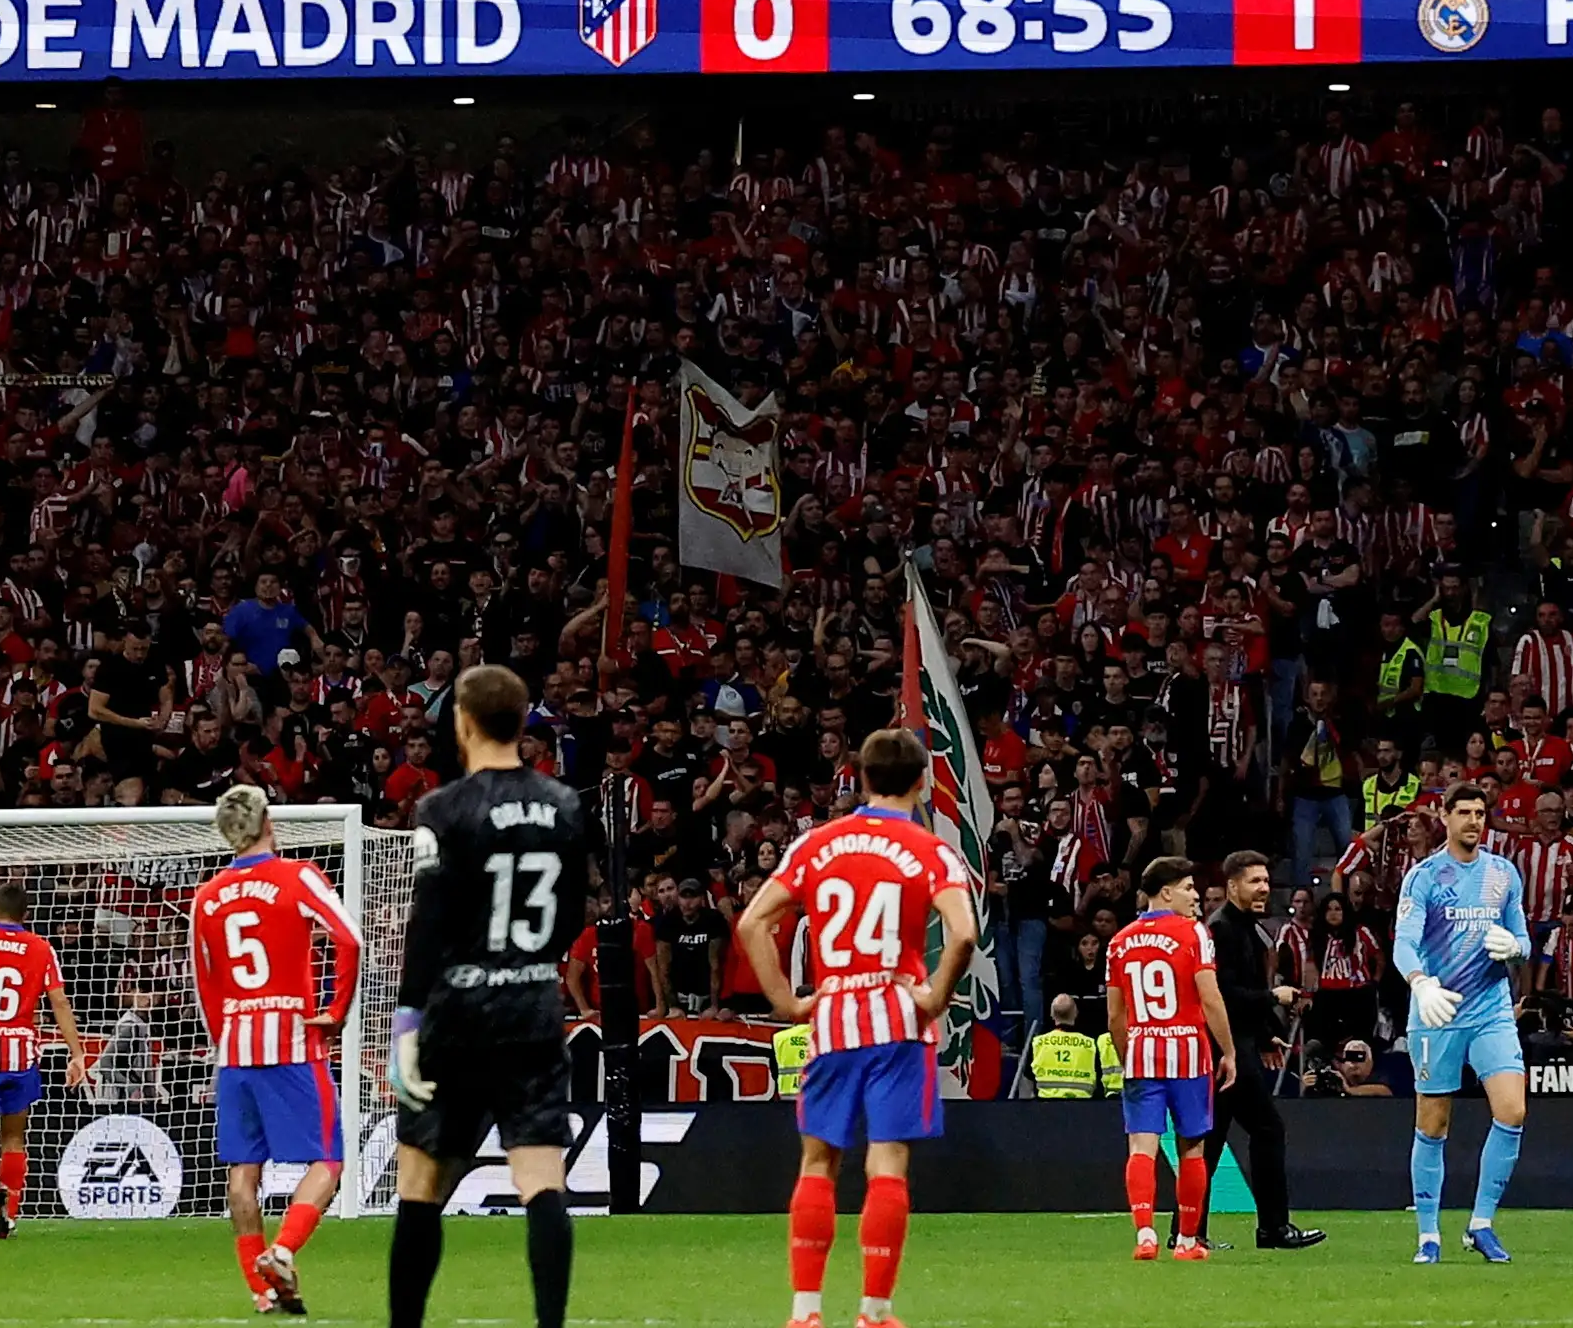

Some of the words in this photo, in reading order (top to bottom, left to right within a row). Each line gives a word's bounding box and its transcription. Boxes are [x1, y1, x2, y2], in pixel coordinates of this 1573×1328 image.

[484, 851, 562, 952] 13
[816, 877, 902, 968] 24
[224, 911, 270, 990] 5
[1124, 960, 1178, 1023] 19
[1038, 1036, 1093, 1048] SEGURIDAD
[1054, 1050, 1071, 1063] 12
[79, 1142, 160, 1183] EA
[77, 1185, 162, 1206] SPORTS
